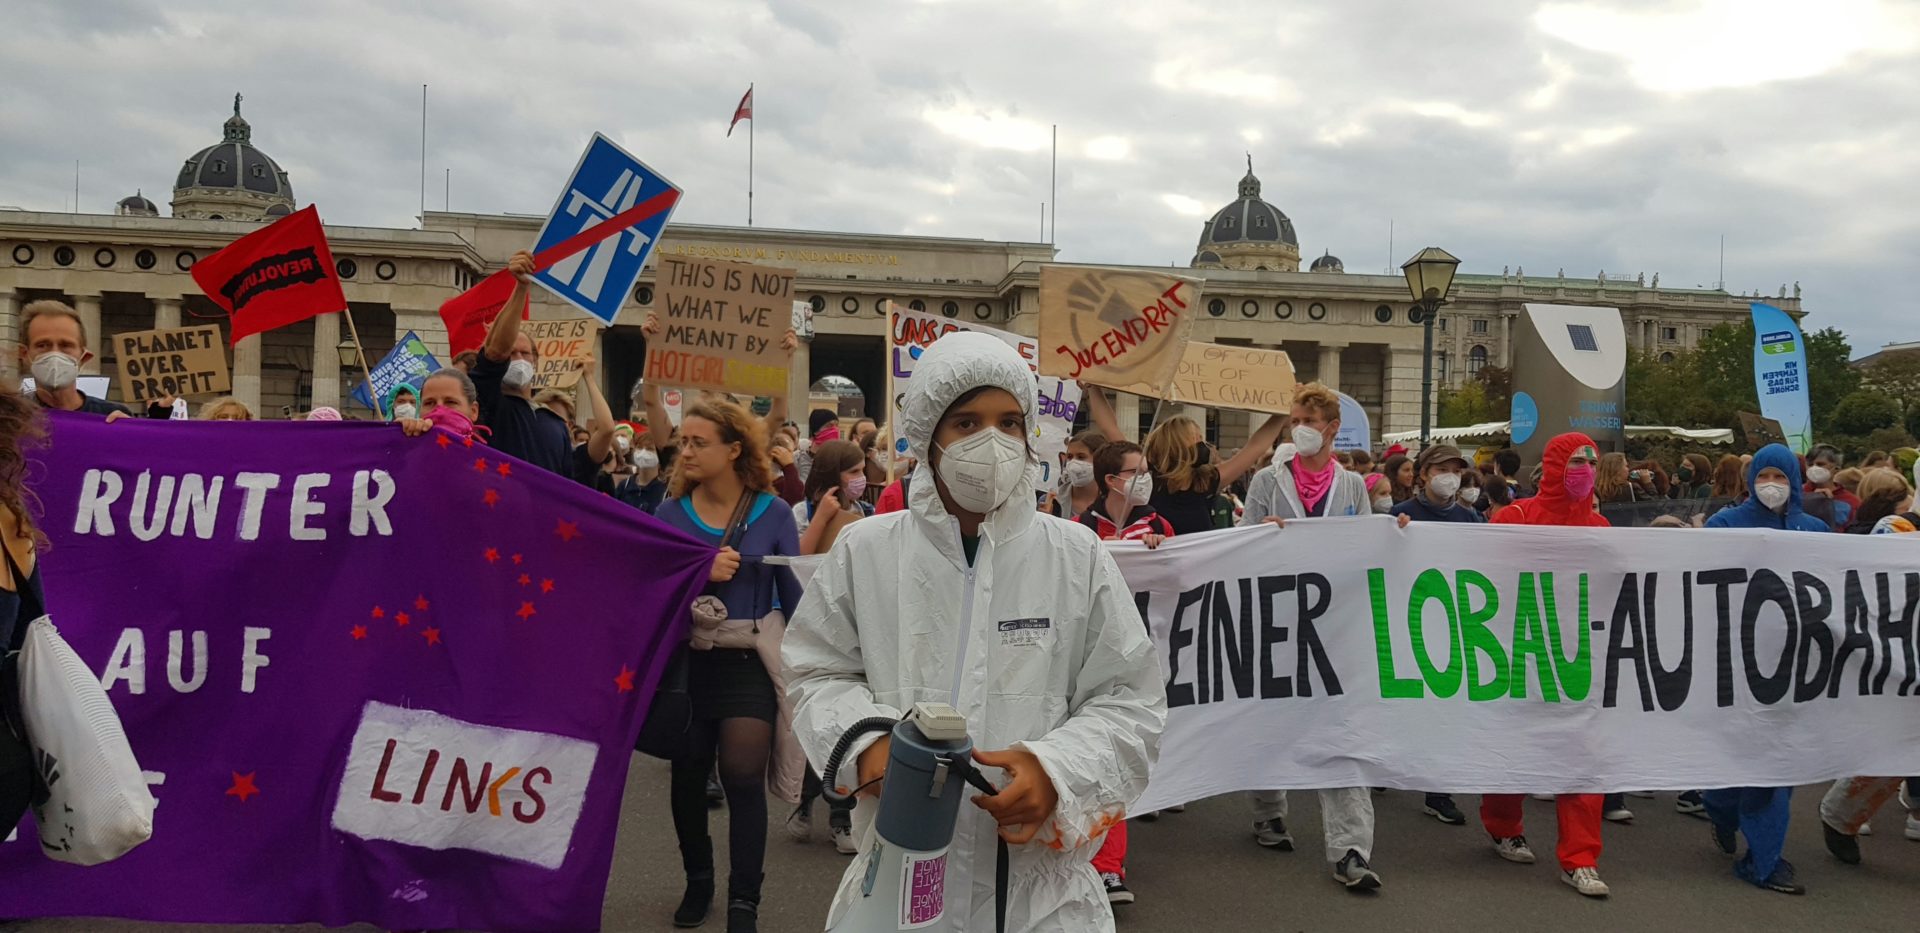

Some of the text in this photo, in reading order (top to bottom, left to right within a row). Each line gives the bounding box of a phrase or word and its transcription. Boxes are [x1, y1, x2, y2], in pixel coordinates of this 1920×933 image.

[665, 259, 794, 298] THIS IS NOT
[666, 292, 728, 322] WHAT
[738, 305, 772, 327] WE
[124, 329, 213, 356] PLANET
[570, 320, 588, 337] IS
[665, 324, 769, 355] MEANT BY
[1056, 280, 1187, 378] JUGENDRAT
[127, 355, 187, 377] OVER
[647, 348, 692, 383] HOT
[1219, 368, 1249, 381] OF
[1245, 351, 1288, 367] OLD
[132, 371, 216, 400] PROFIT
[74, 468, 396, 541] RUNTER
[1367, 567, 1920, 712] LOBAU-AUTOBAH
[102, 626, 272, 694] AUF
[370, 738, 554, 823] LINKS
